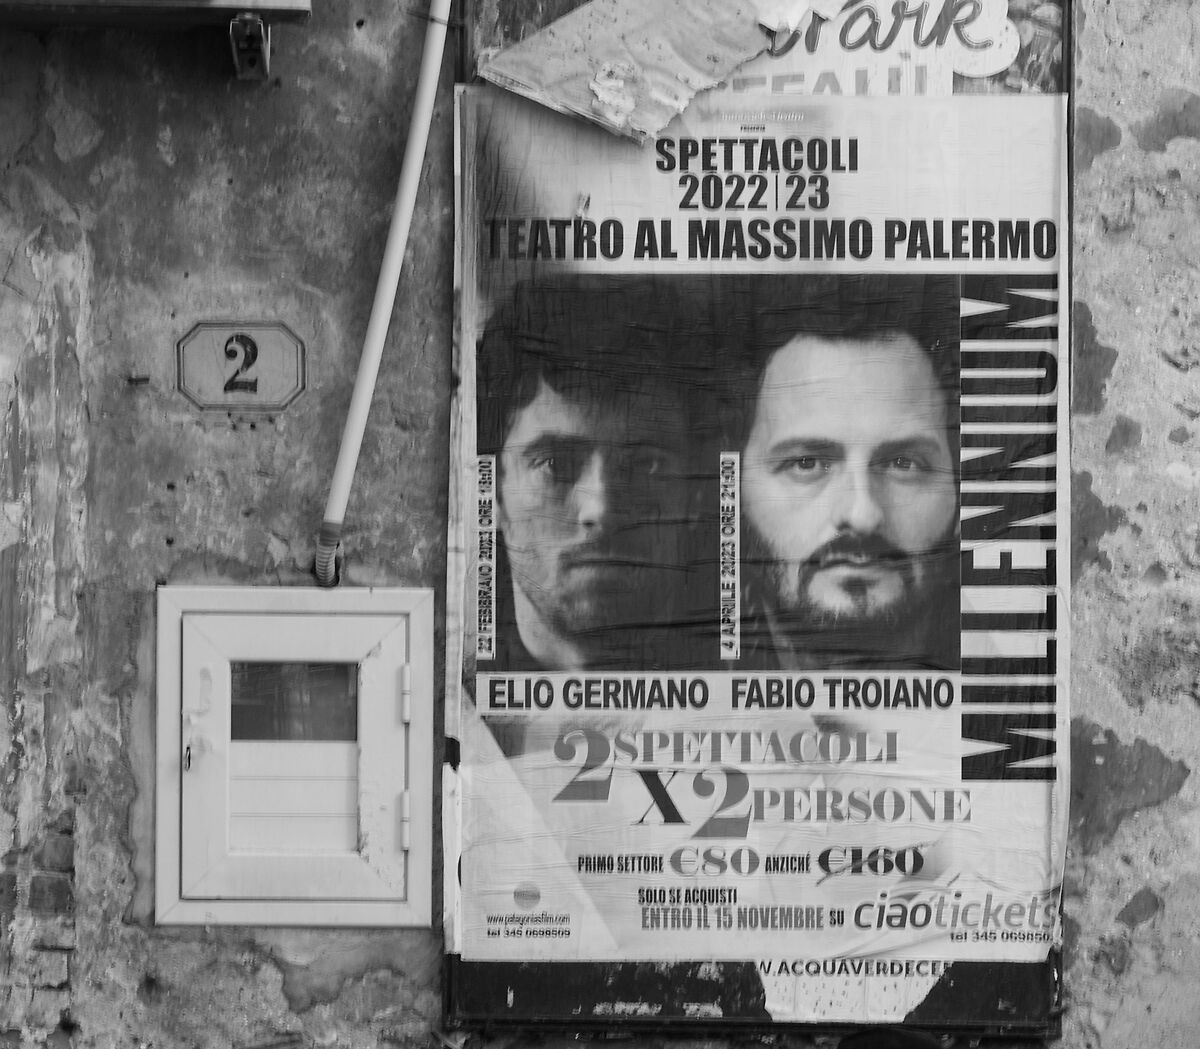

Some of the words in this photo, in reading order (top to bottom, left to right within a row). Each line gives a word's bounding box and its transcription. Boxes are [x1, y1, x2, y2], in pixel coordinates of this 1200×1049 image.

[655, 137, 859, 172] SPETTACOLI
[488, 219, 625, 260] TEATRO
[634, 219, 678, 259] AL
[688, 219, 874, 260] MASSIMO
[885, 219, 1058, 260] PALERMO
[224, 334, 260, 393] 2
[721, 460, 735, 500] 21:00
[478, 499, 493, 526] ORE
[721, 505, 735, 537] ORE
[960, 275, 1058, 781] MILLENNIUM
[721, 542, 735, 577] 2023
[478, 565, 493, 634] FEBBRAIO
[721, 582, 735, 637] APRILE
[489, 678, 555, 710] ELIO
[562, 678, 709, 710] GERMANO
[731, 678, 815, 709] FABIO
[823, 678, 955, 709] TROIANO
[753, 787, 972, 823] PERSONE
[577, 853, 614, 873] PRIMO
[617, 853, 664, 873] SETTORE
[670, 846, 759, 877] €80
[765, 852, 811, 874] ANZICHÉ
[817, 847, 925, 876] €160
[638, 887, 666, 904] SOLO
[684, 887, 737, 906] ACQUISTI
[641, 906, 692, 930] ENTRO
[697, 906, 710, 930] IL
[714, 906, 733, 930] 15
[737, 905, 824, 930] NOVEMBRE
[829, 909, 845, 926] SU
[853, 892, 1057, 930] ciaotickets
[951, 930, 967, 942] tel
[972, 930, 996, 942] 345
